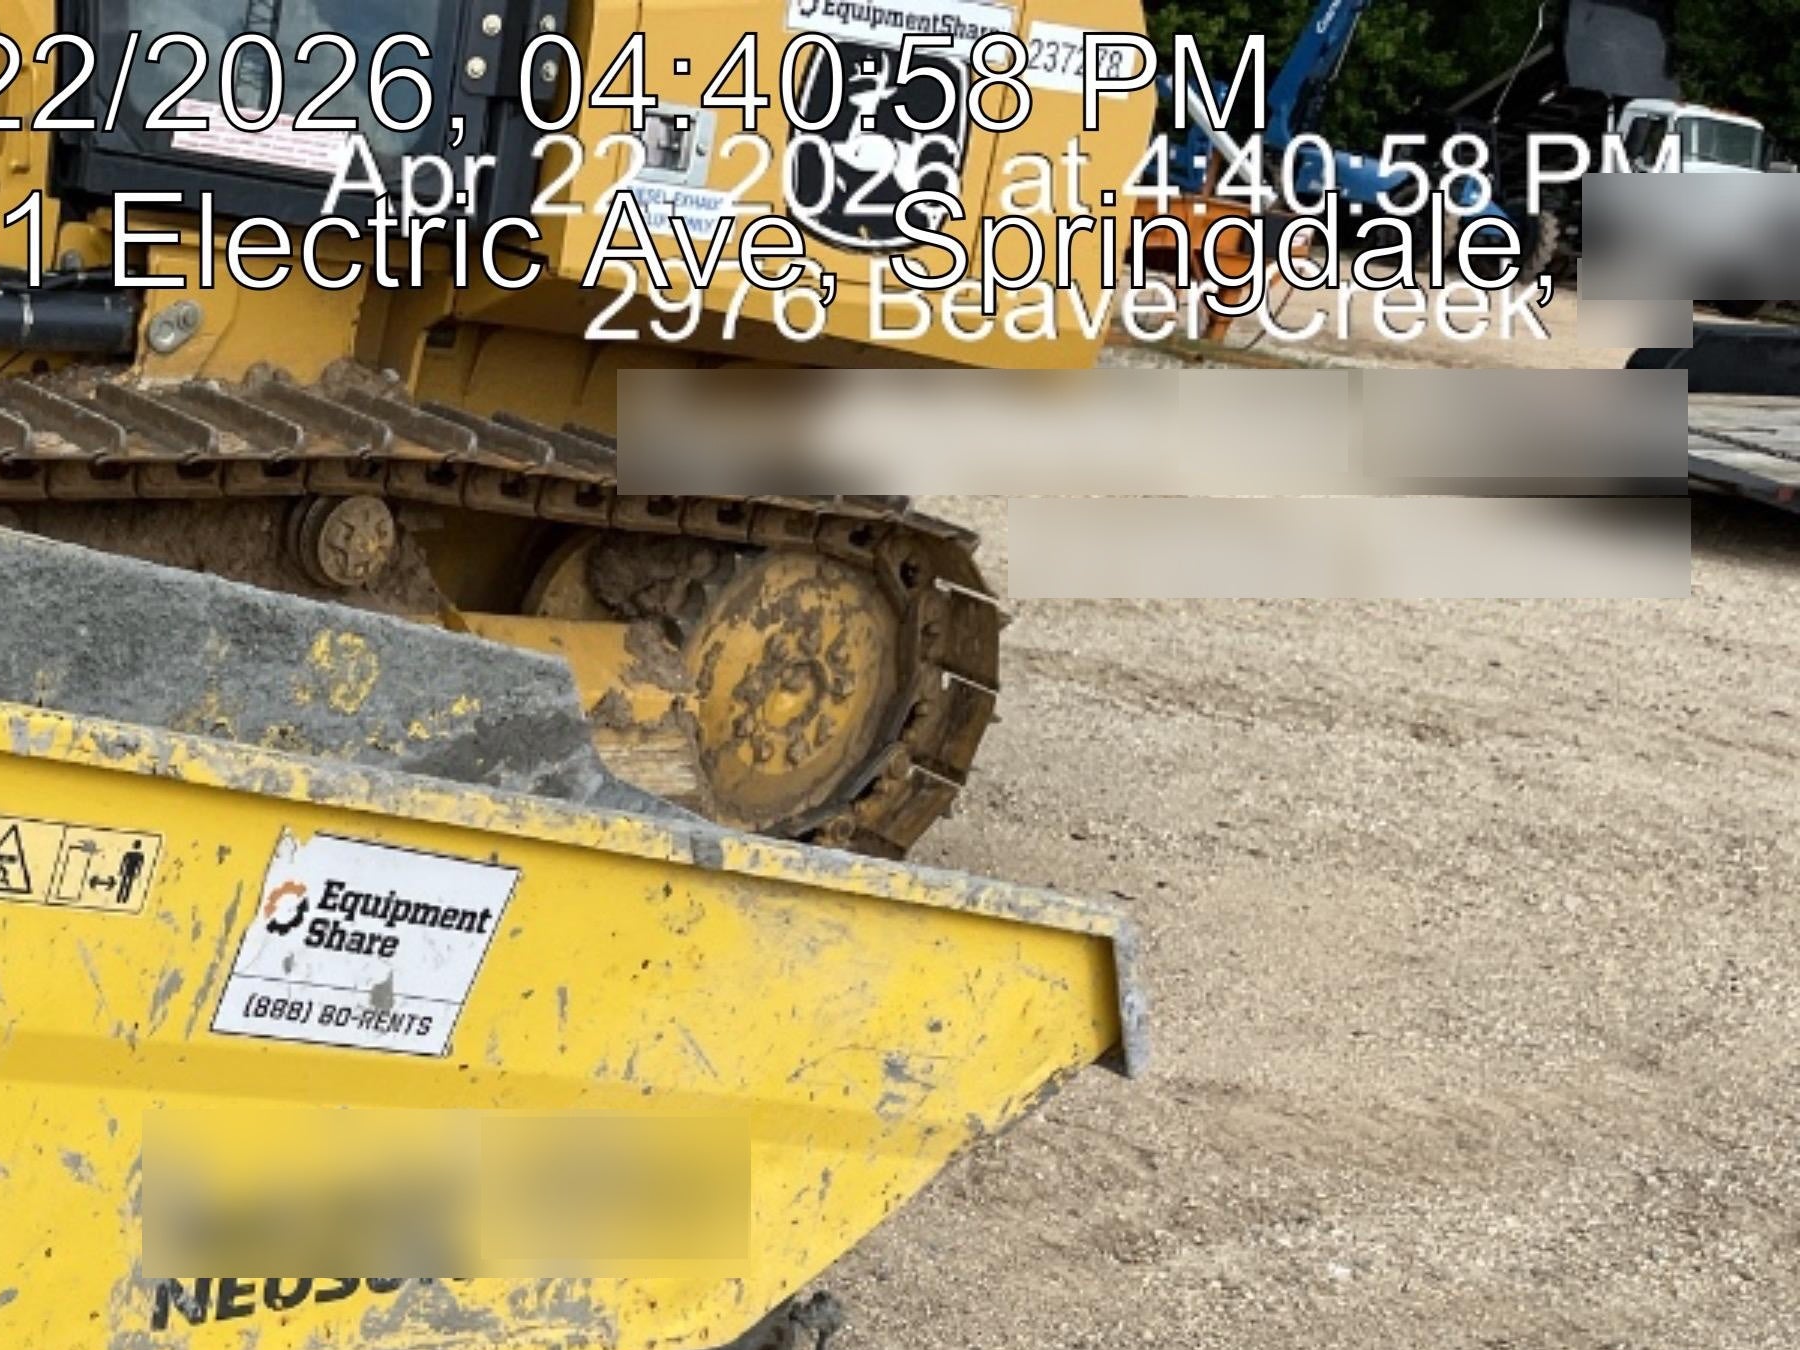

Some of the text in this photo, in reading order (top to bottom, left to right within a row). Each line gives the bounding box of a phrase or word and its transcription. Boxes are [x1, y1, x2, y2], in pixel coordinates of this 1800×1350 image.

[317, 878, 493, 934] Equipment
[304, 917, 400, 958] Share
[243, 993, 314, 1025] (888)
